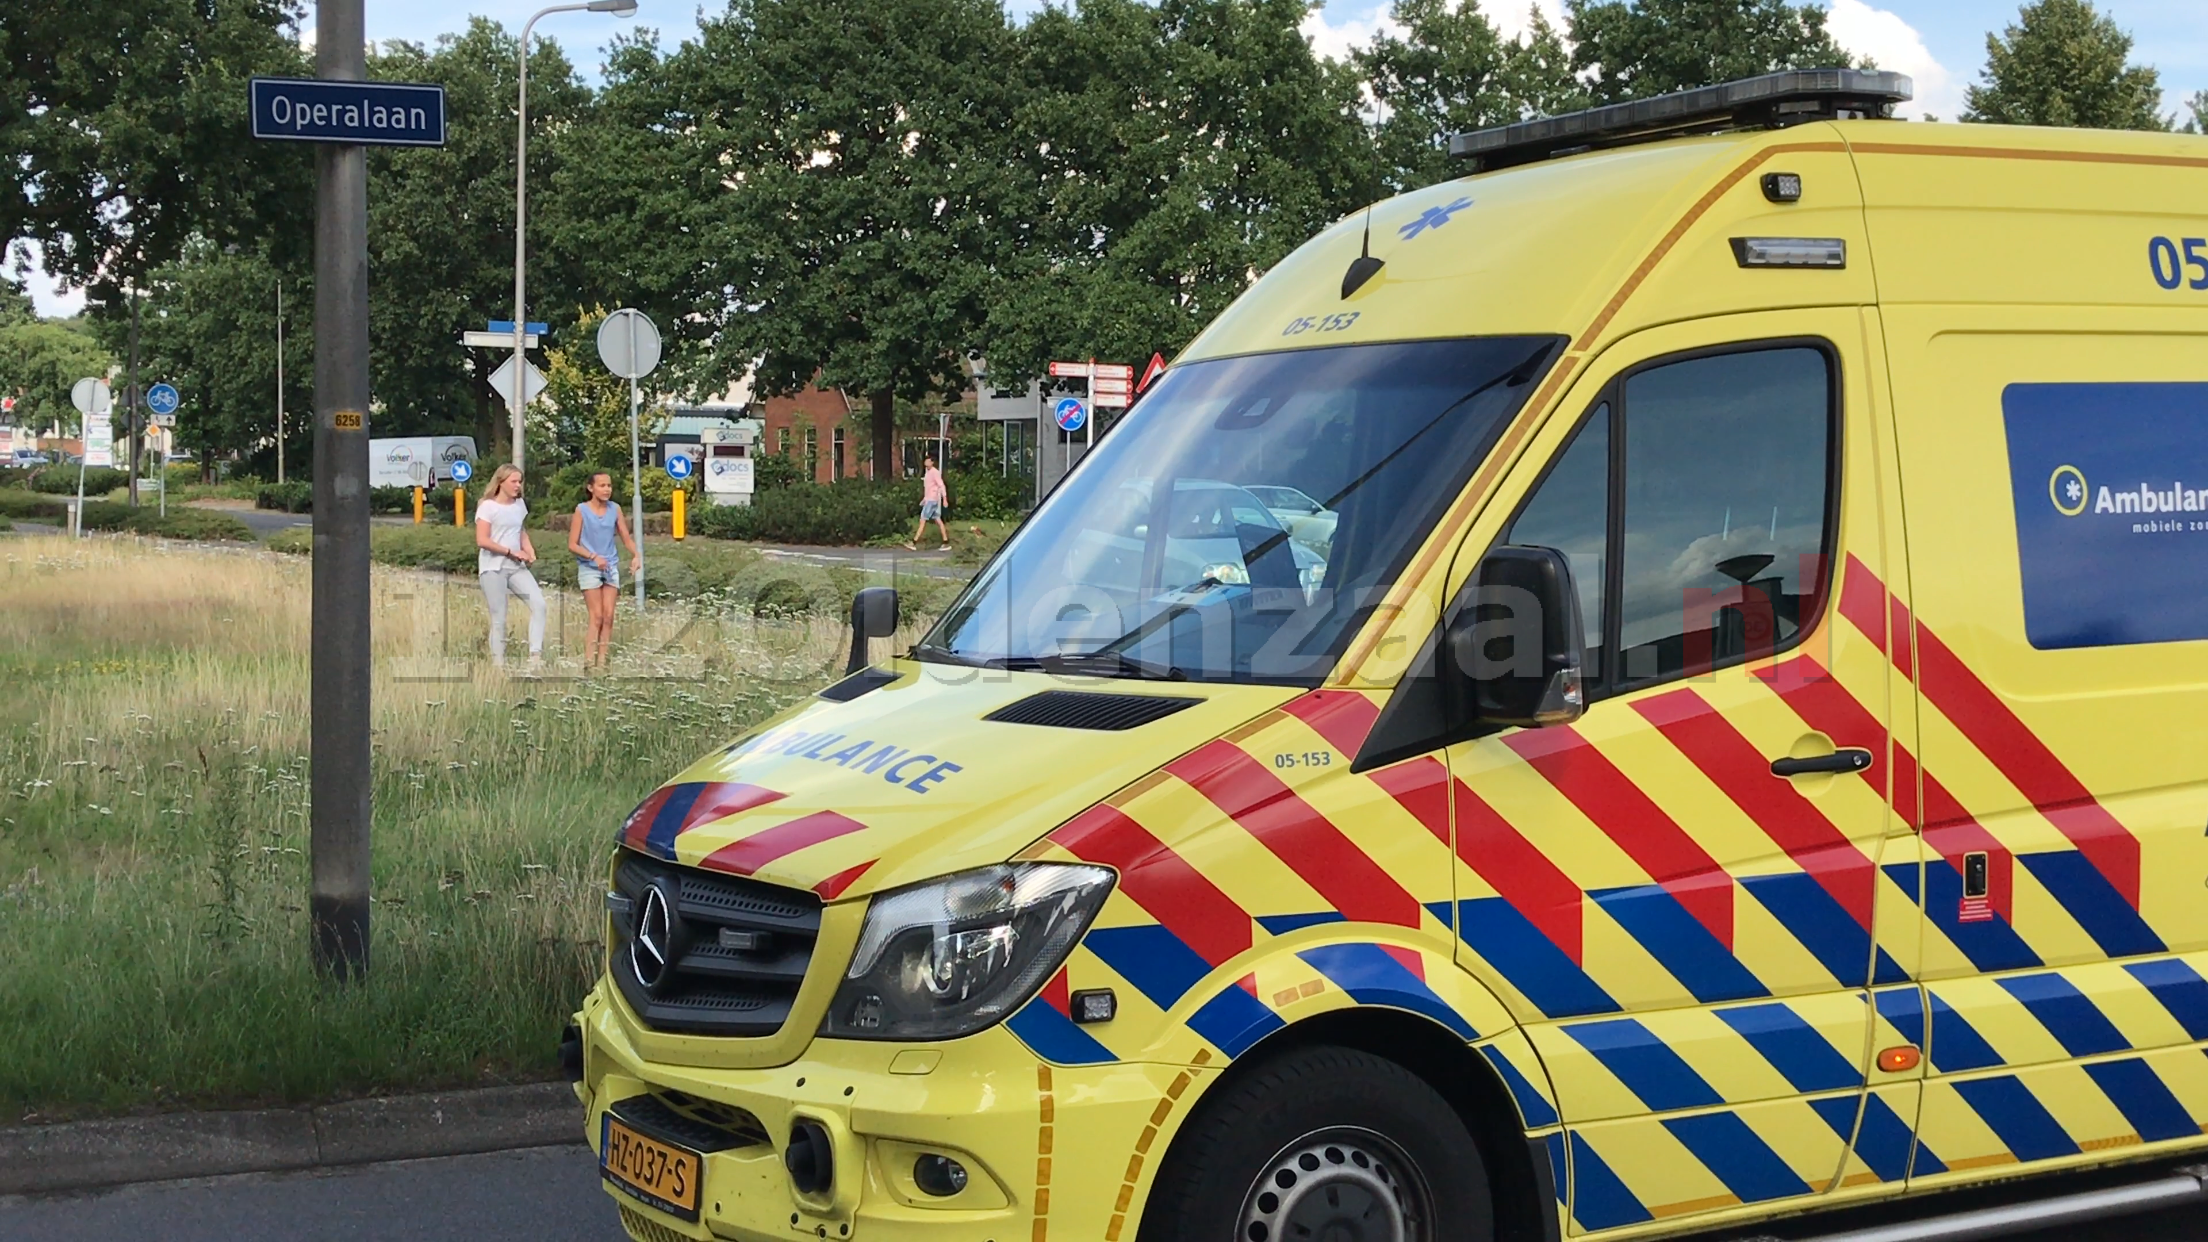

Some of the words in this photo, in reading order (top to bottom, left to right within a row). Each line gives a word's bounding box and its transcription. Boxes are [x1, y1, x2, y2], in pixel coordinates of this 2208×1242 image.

[271, 95, 427, 131] Operalaan
[1282, 311, 1361, 336] 05-153
[335, 414, 362, 427] 6258
[2132, 519, 2183, 533] mobiele
[733, 732, 964, 794] BULANCE
[1275, 752, 1331, 768] 05-153
[611, 1128, 686, 1198] HZ-037-S
